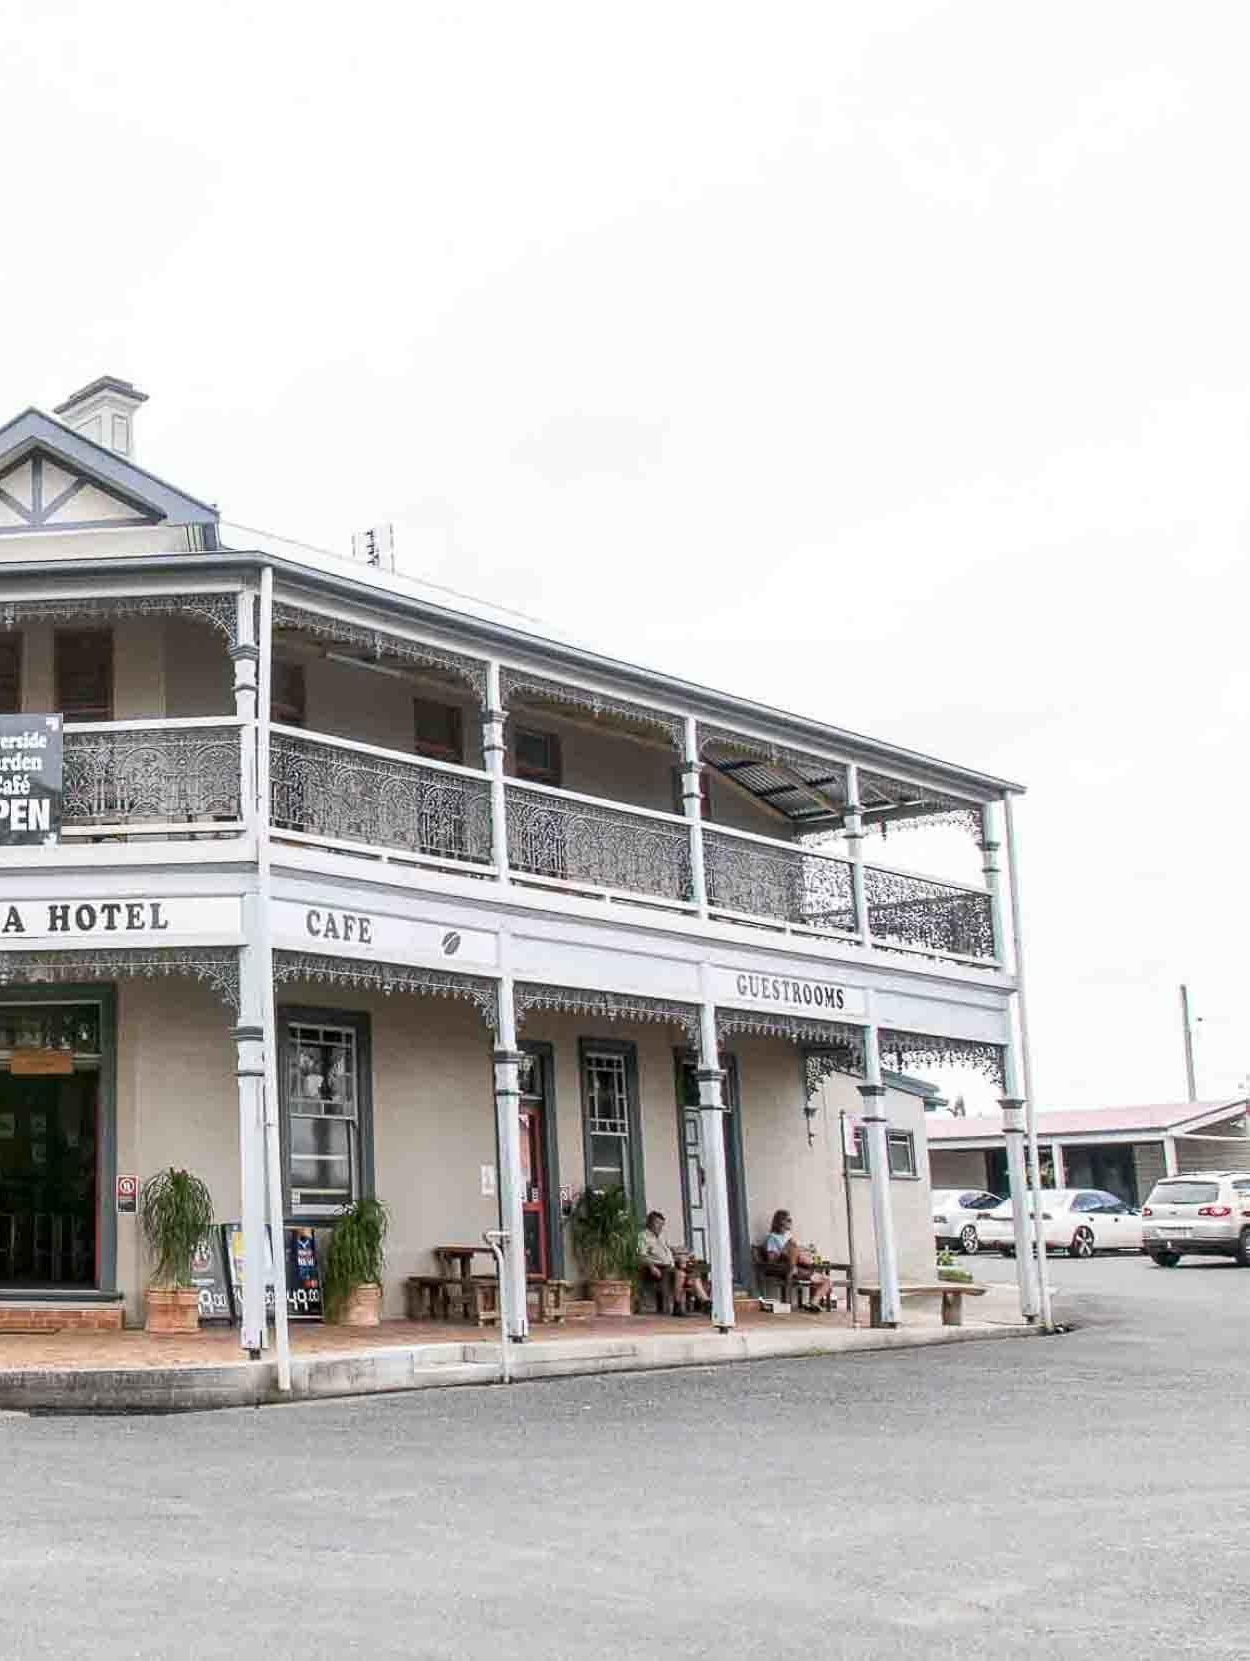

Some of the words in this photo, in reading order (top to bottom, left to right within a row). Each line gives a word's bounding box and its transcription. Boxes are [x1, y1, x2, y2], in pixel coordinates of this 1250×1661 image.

[47, 902, 168, 932] HOTEL
[306, 909, 372, 944] CAFE
[736, 974, 845, 1010] GUESTROOMS
